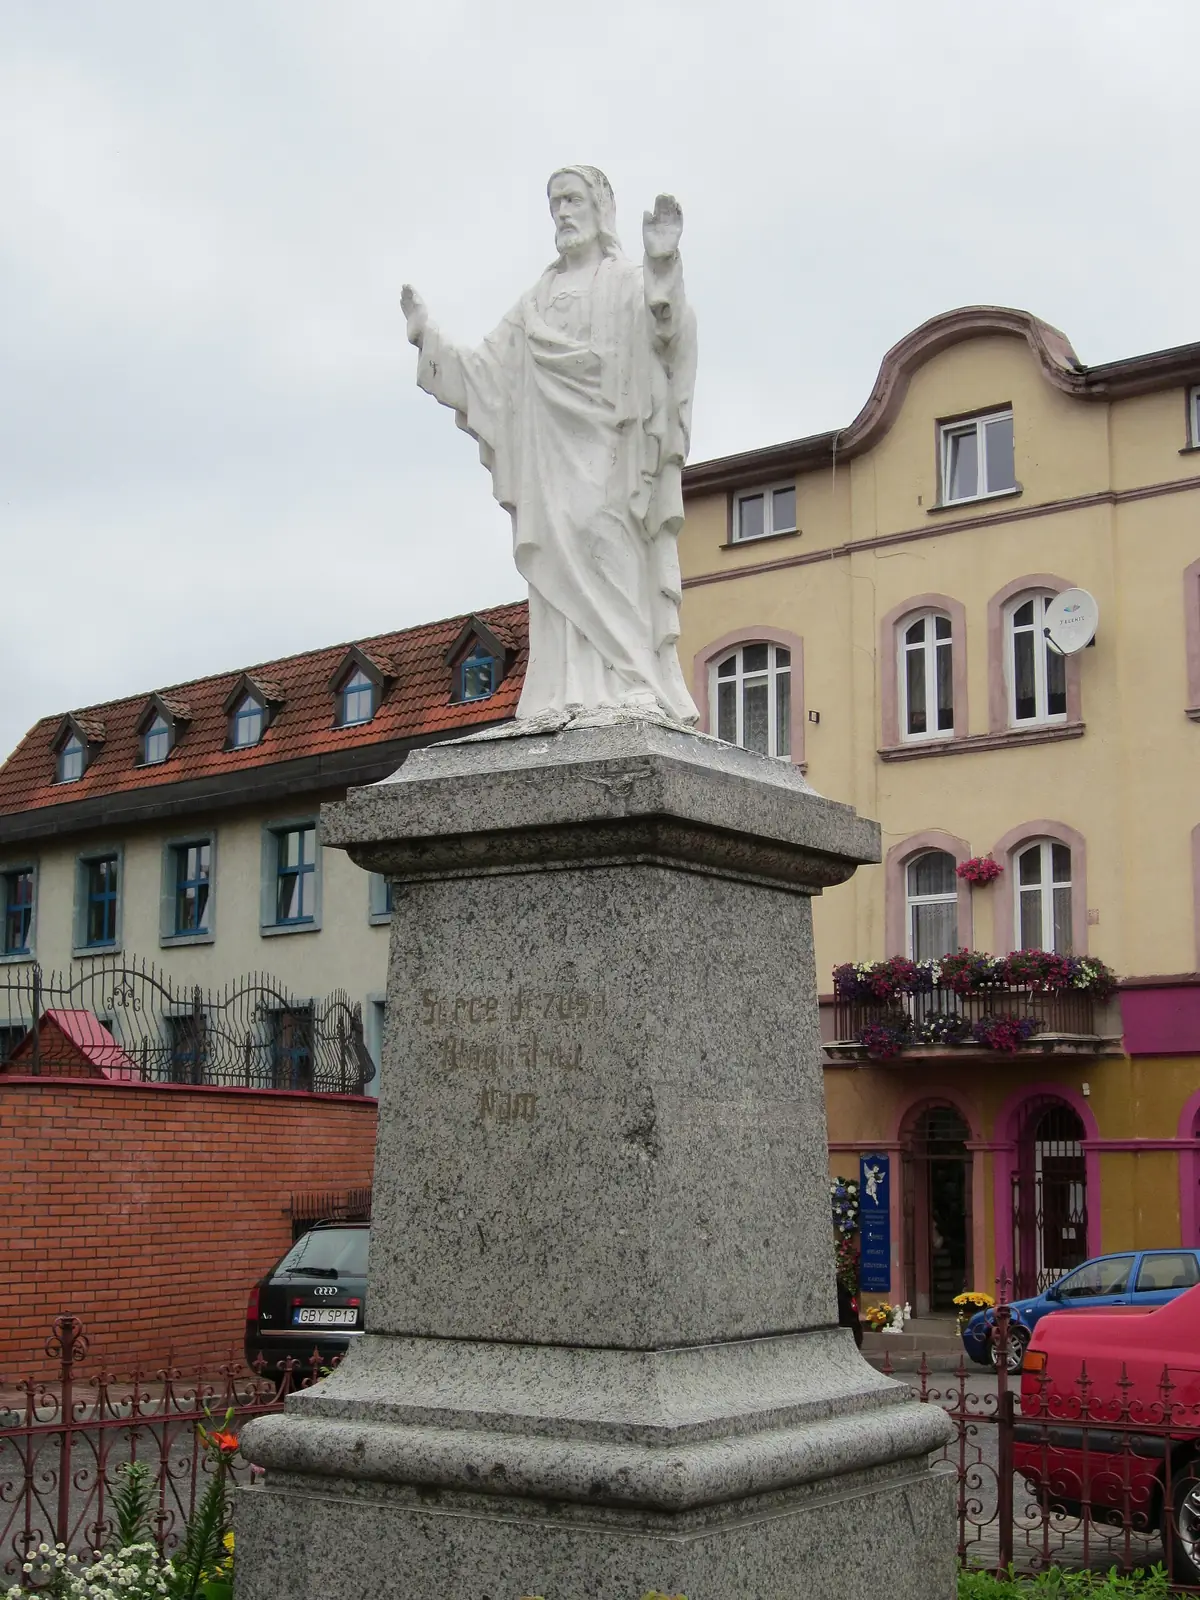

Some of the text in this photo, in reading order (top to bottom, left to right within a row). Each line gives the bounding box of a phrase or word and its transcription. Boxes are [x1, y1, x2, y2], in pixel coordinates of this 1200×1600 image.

[479, 1085, 538, 1123] Nam
[300, 1309, 355, 1322] GBY SP13
